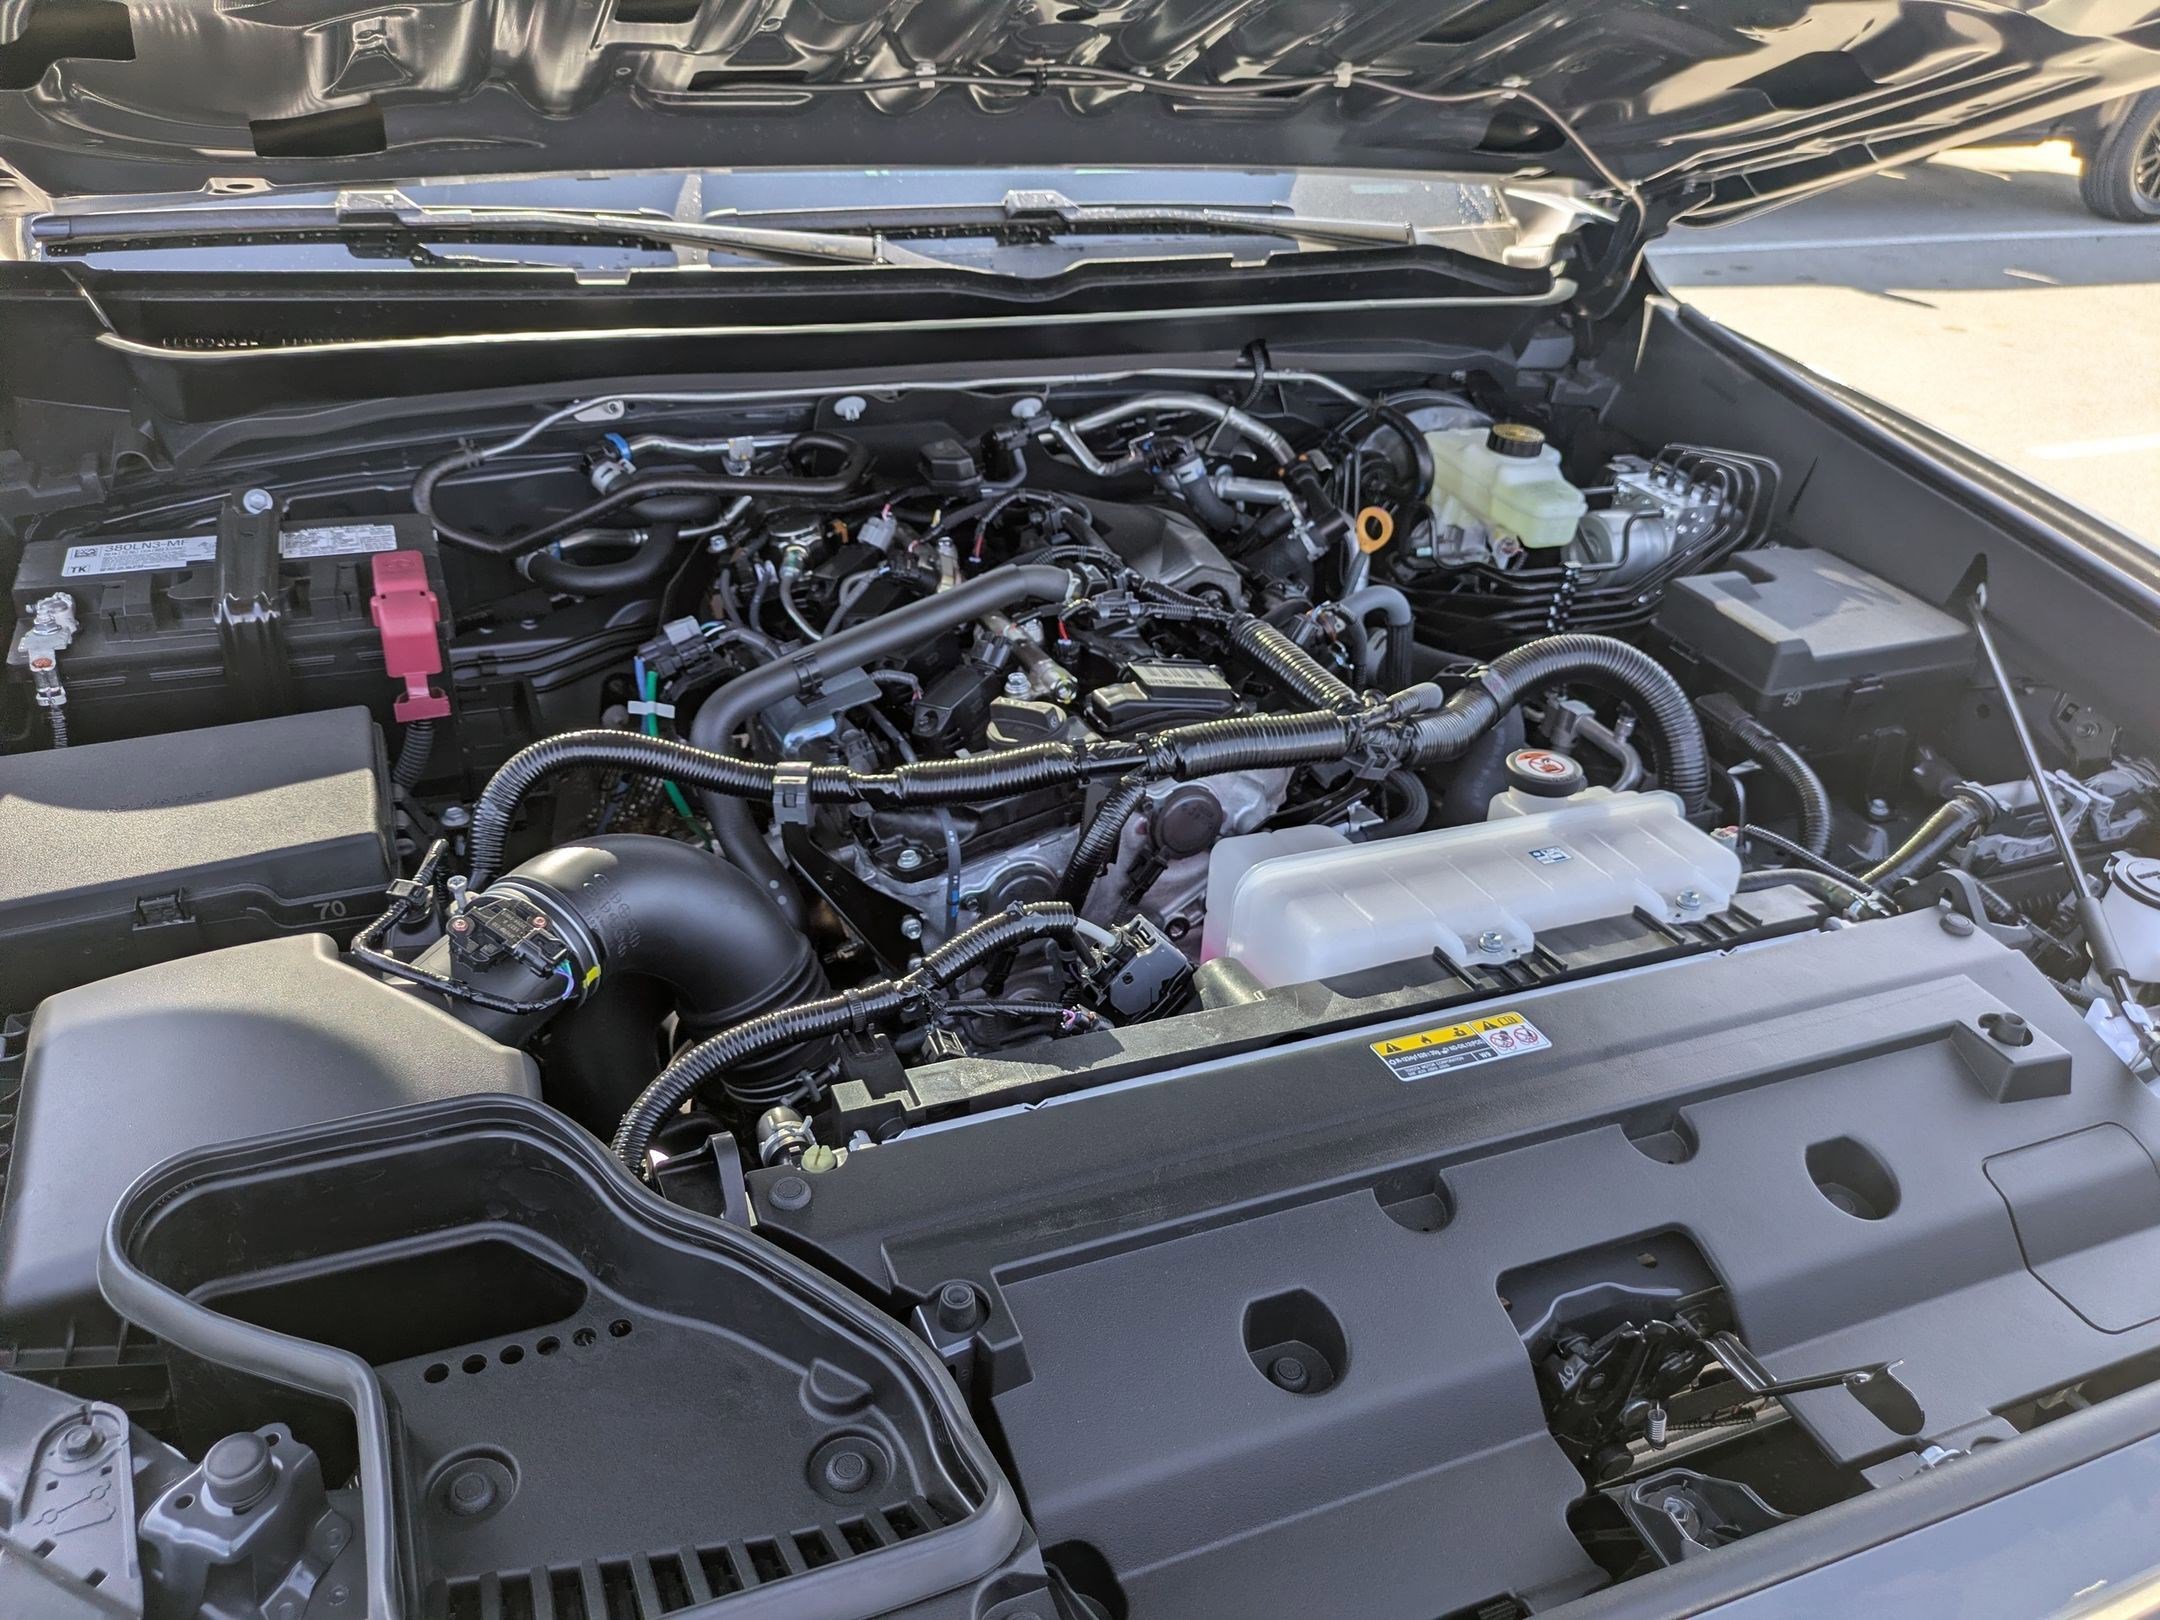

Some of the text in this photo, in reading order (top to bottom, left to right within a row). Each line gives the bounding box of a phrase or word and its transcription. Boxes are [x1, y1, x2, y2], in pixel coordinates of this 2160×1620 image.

[70, 565, 87, 574] TK
[1782, 691, 1802, 707] 50
[313, 900, 347, 920] 70
[1558, 1366, 1575, 1390] A9
